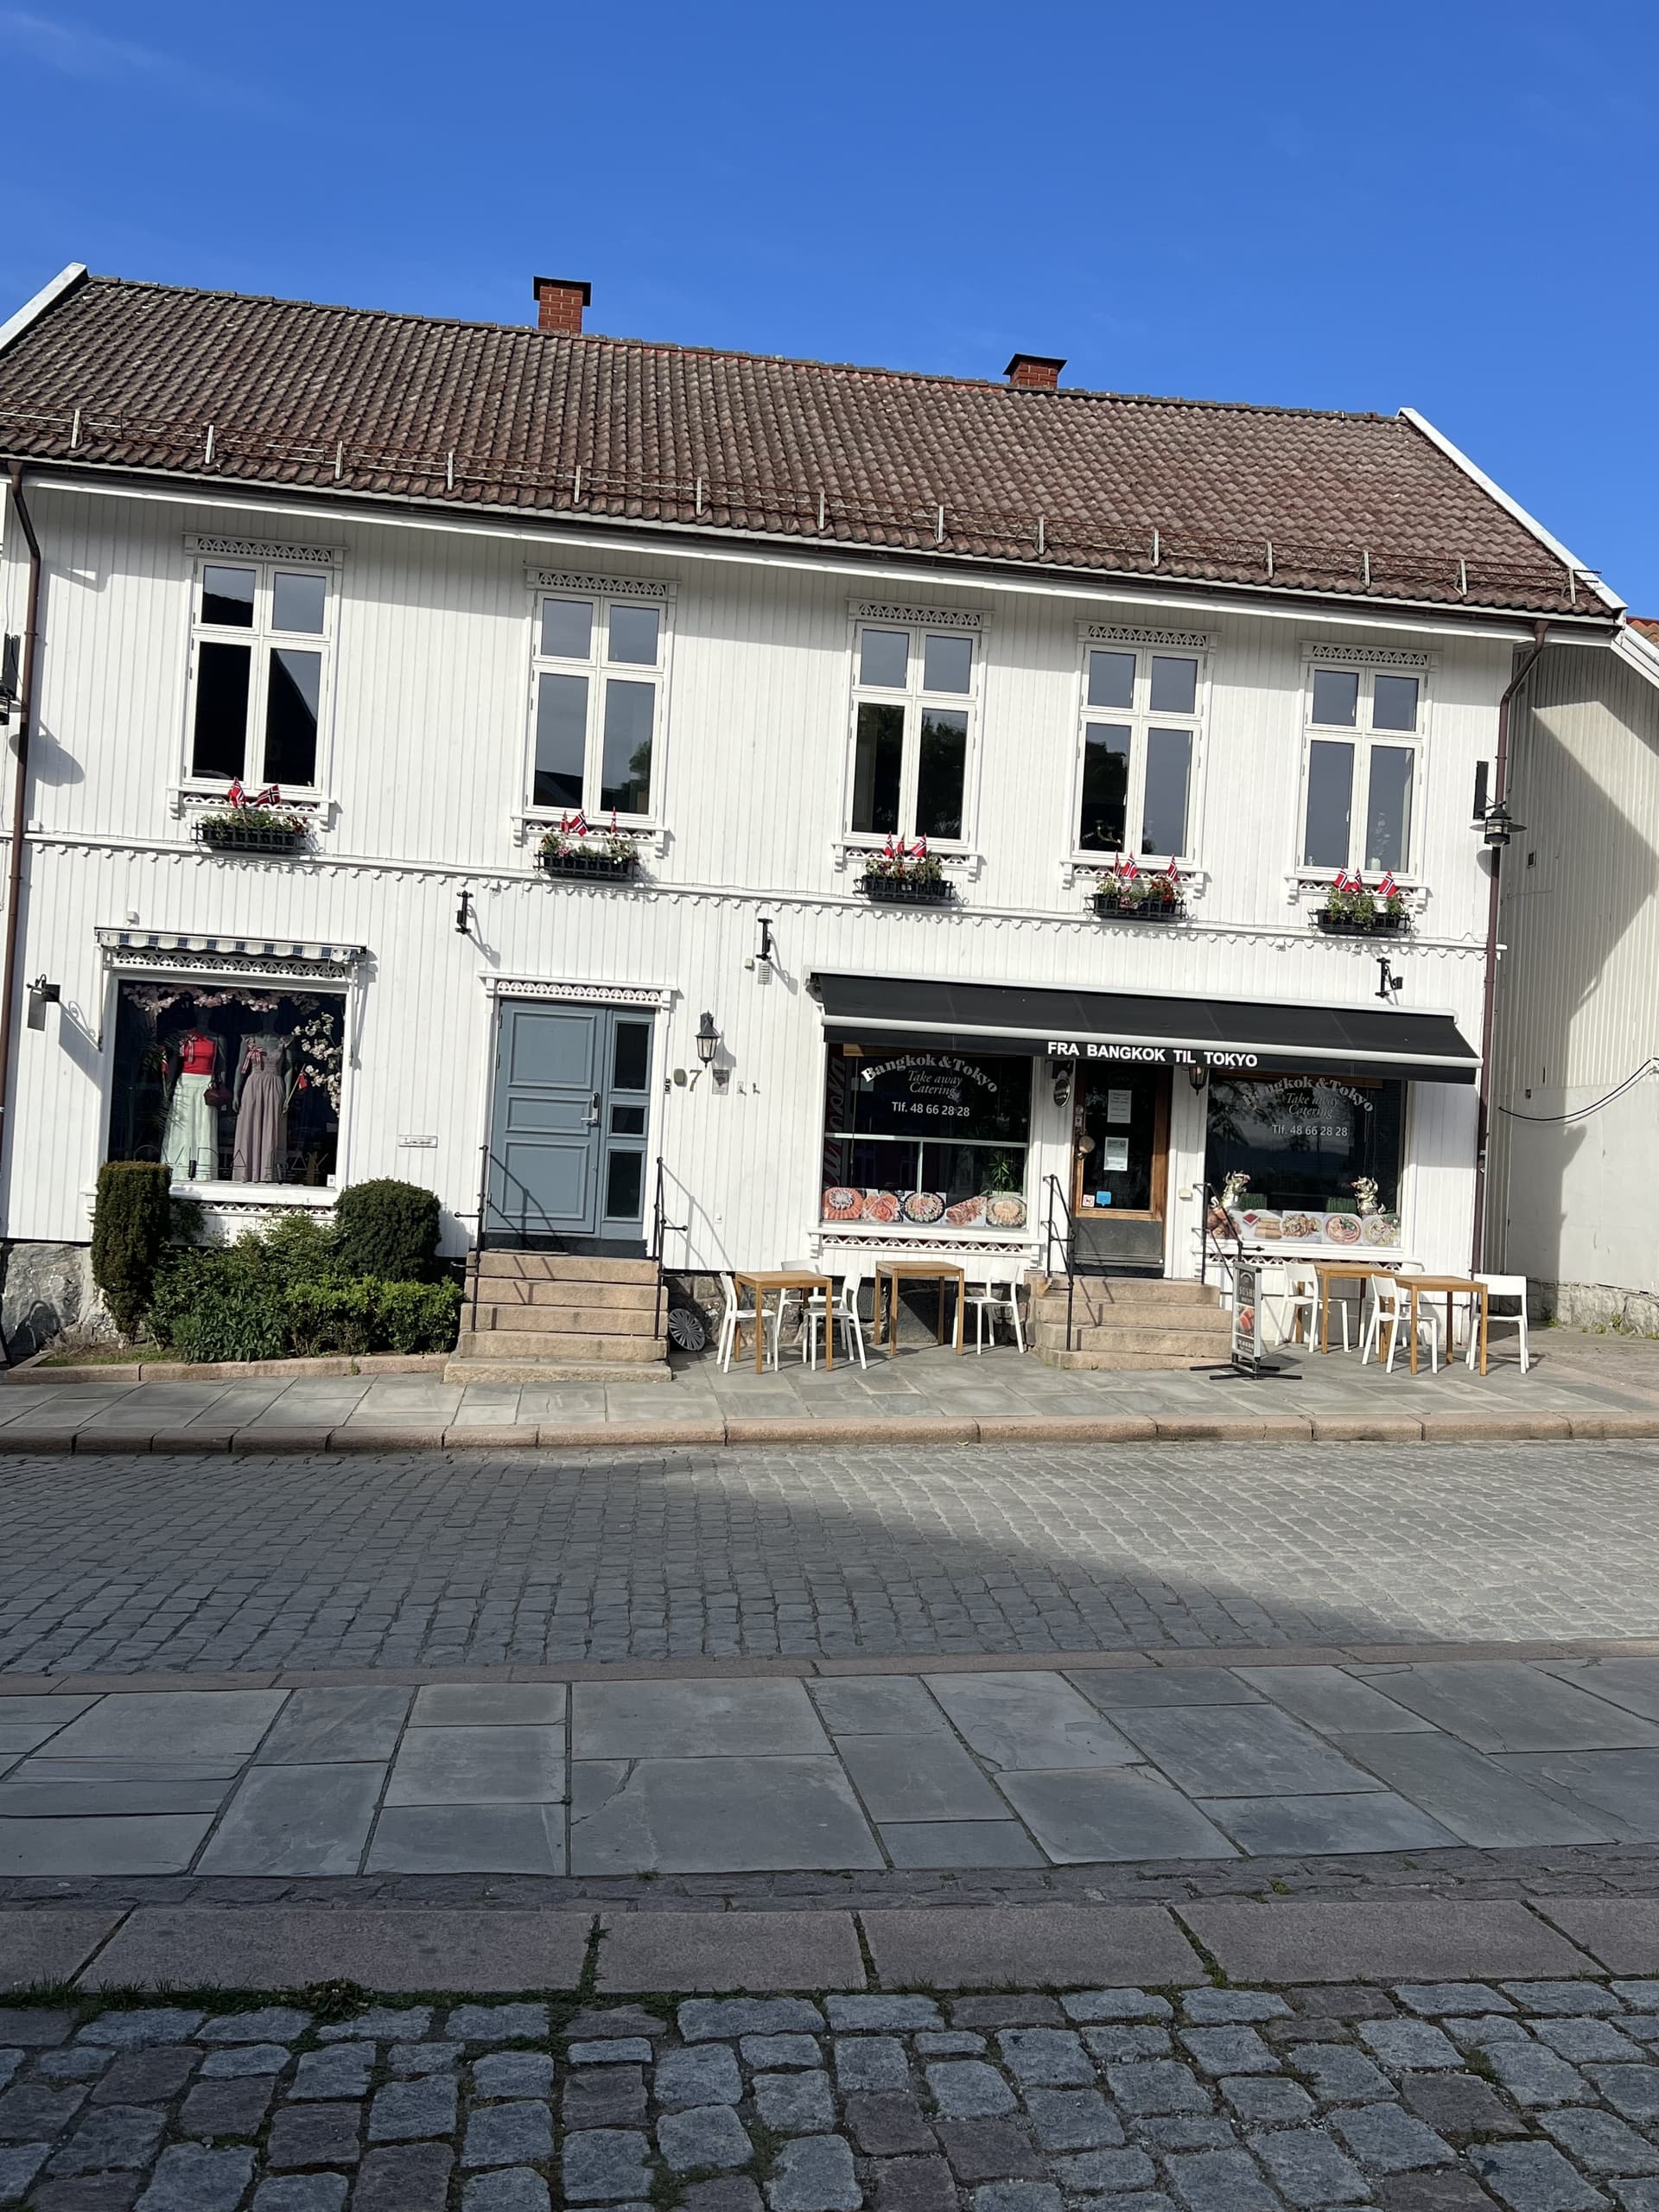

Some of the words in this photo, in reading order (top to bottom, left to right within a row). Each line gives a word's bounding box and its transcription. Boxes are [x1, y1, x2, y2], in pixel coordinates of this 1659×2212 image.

[1047, 1041, 1080, 1056] FRA
[1086, 1044, 1166, 1062] BANGKOK
[1173, 1049, 1197, 1064] TIL
[1204, 1051, 1258, 1067] TOKYO
[689, 1069, 702, 1092] 7
[861, 1053, 938, 1083] Bangkok
[953, 1058, 998, 1093] Tokyo
[908, 1070, 932, 1082] Take
[934, 1075, 963, 1088] away
[910, 1081, 959, 1100] Catering
[1286, 1092, 1310, 1105] Take
[1329, 1079, 1374, 1112] Tokyo
[892, 1101, 908, 1113] Tlf.
[910, 1103, 924, 1114] 48
[925, 1103, 939, 1115] 66
[941, 1105, 955, 1116] 28
[957, 1106, 970, 1117] 28
[1287, 1103, 1333, 1120] Catering
[1271, 1124, 1287, 1135] Tlf.
[1289, 1125, 1303, 1135] 48
[1305, 1125, 1319, 1136] 66
[1319, 1126, 1333, 1136] 28
[1335, 1127, 1349, 1137] 28
